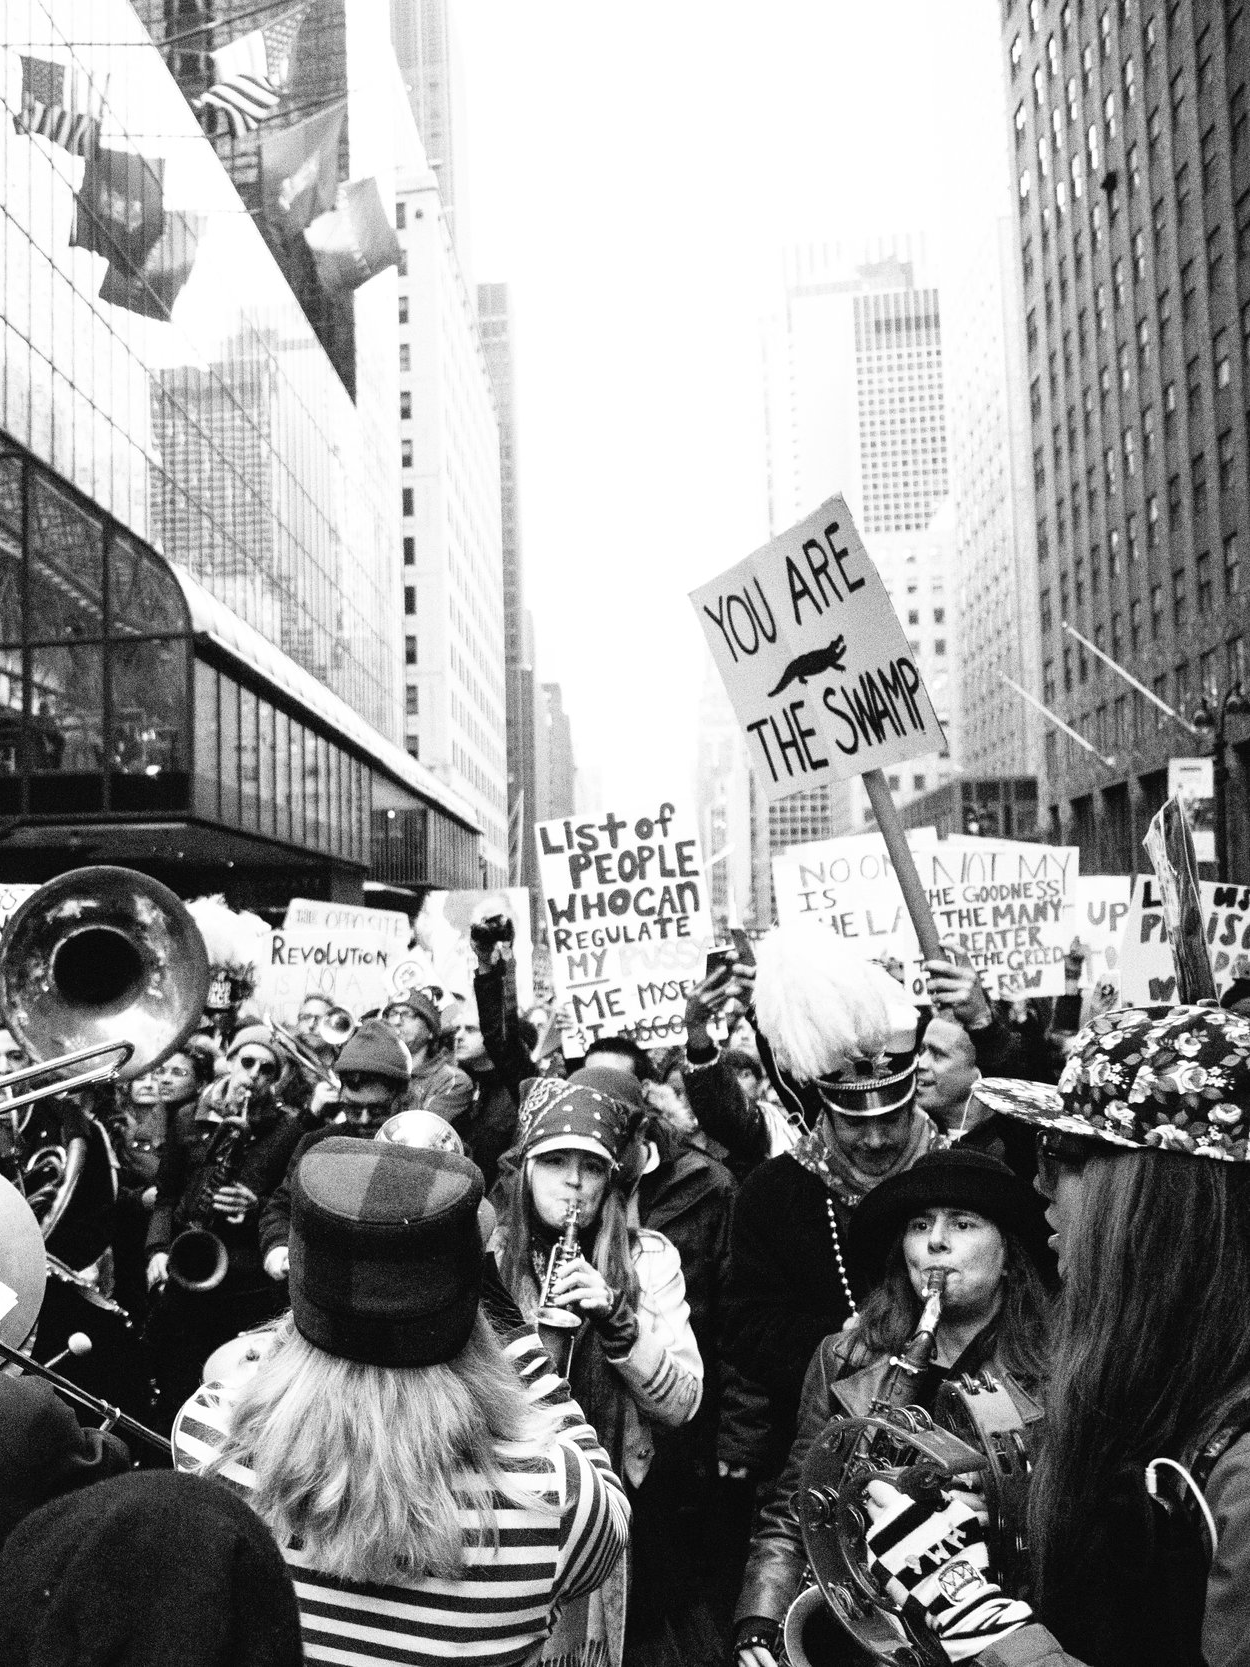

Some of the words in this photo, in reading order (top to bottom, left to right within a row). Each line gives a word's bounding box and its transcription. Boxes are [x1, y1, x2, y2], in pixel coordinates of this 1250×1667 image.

[704, 577, 777, 663] YOU
[786, 521, 866, 626] ARE
[747, 700, 830, 782] THE
[823, 656, 927, 755] SWAMP
[635, 802, 675, 840] of
[568, 840, 699, 889] PEOPLE
[1019, 852, 1071, 895] MY
[797, 888, 836, 913] IS
[963, 880, 1061, 903] GOODNESS
[940, 907, 988, 928] THE
[992, 898, 1062, 928] MANY
[1087, 901, 1129, 932] UP
[271, 934, 388, 968] REVOLUTION
[554, 916, 691, 954] REGULATE
[567, 948, 607, 980] MY
[573, 988, 626, 1024] ME
